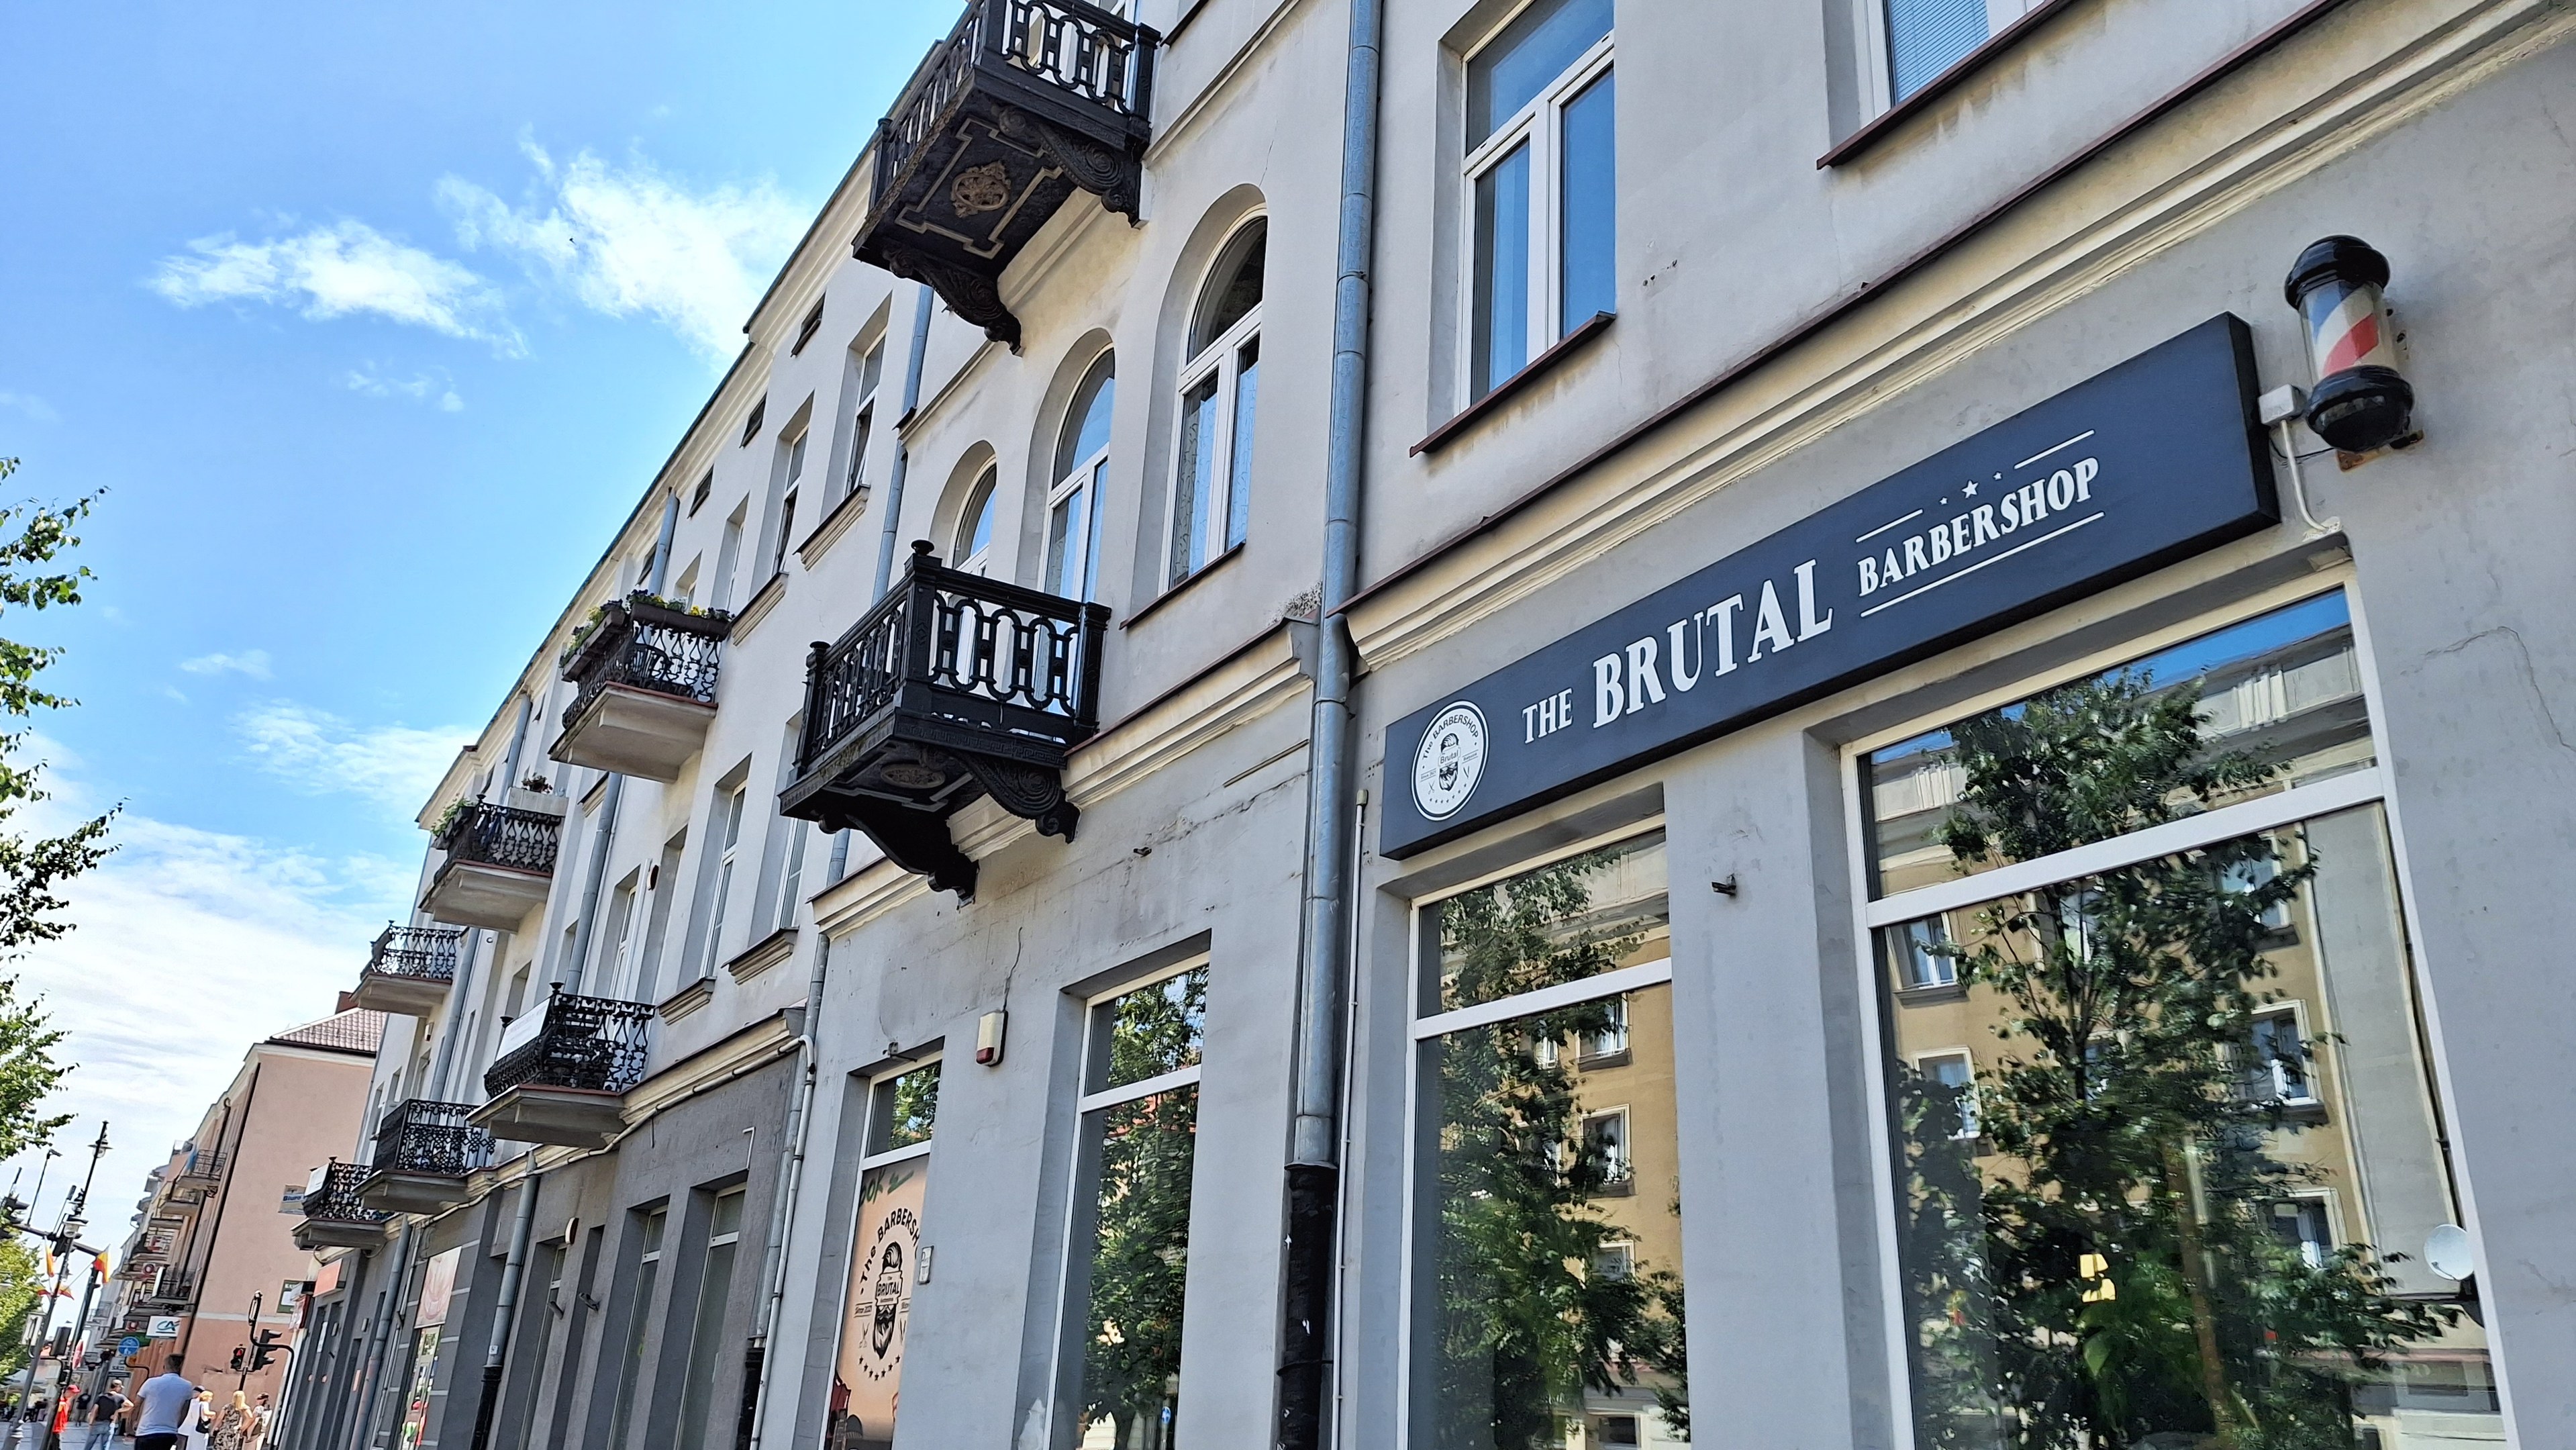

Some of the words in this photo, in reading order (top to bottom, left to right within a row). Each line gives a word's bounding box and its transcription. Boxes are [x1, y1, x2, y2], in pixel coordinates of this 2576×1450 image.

[1522, 689, 1573, 744] THE
[1593, 559, 1833, 728] BRUTAL
[1858, 458, 2099, 597] BARBERSHOP
[1432, 714, 1479, 740] BARBERSHOP
[1440, 749, 1458, 765] Brutal
[877, 1282, 899, 1296] BRUTAL
